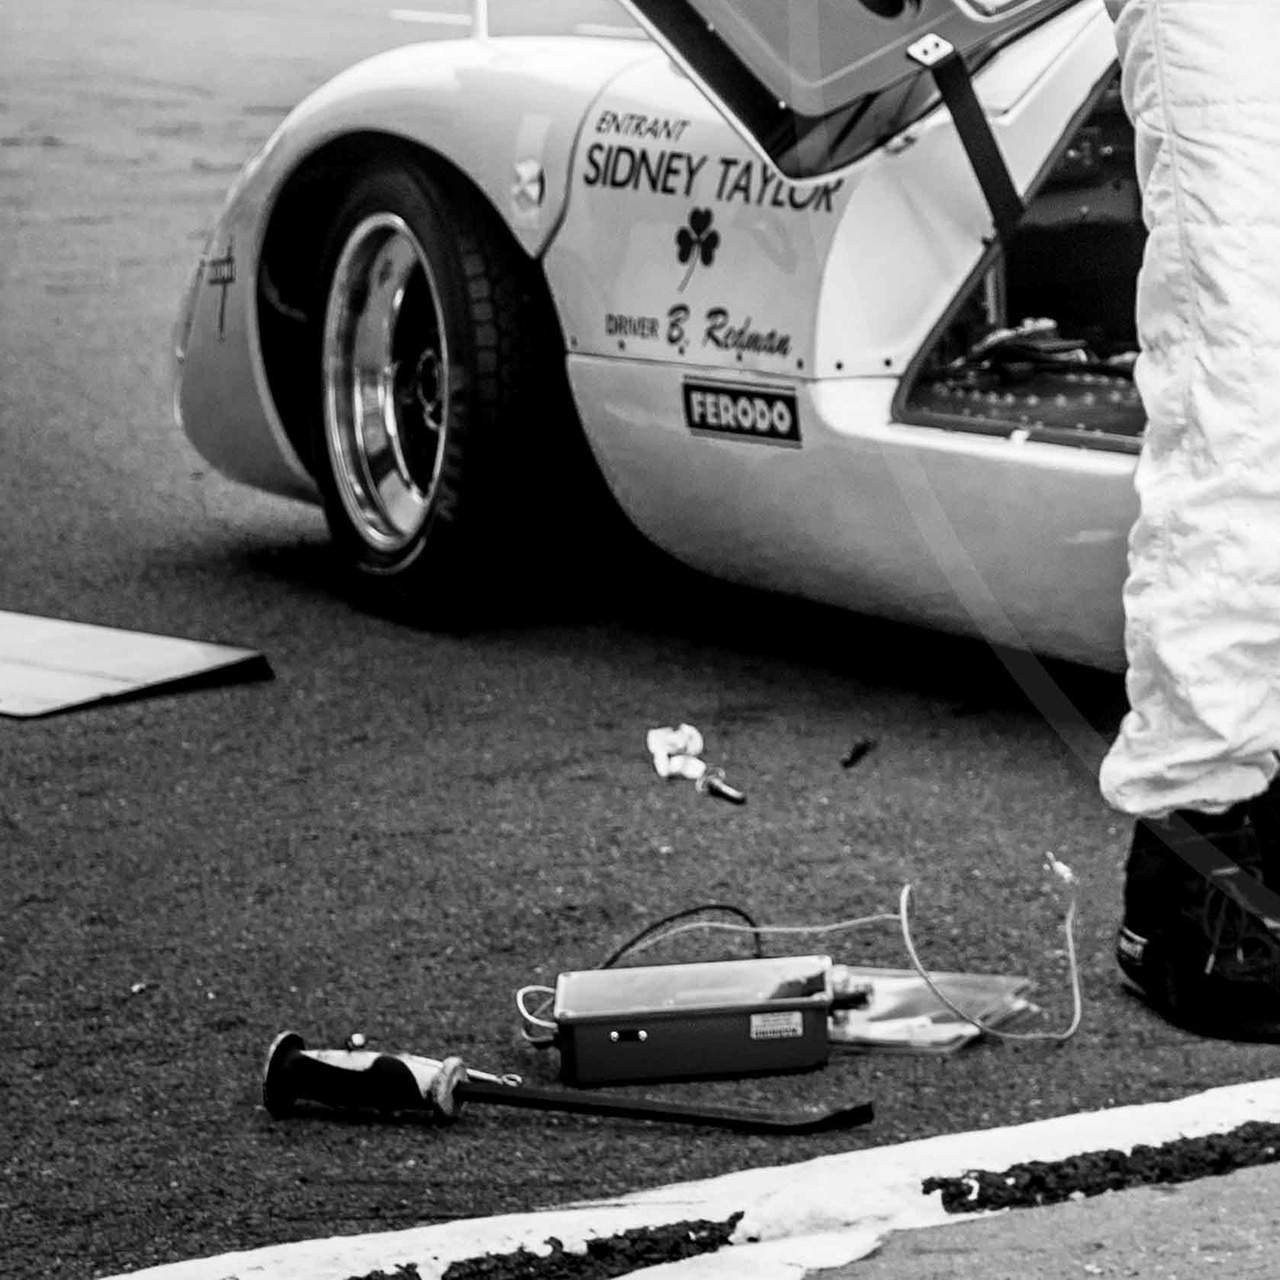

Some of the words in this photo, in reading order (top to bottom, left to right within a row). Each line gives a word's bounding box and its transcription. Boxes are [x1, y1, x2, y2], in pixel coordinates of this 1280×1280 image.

[596, 111, 690, 142] ENTRANT
[583, 143, 708, 197] SIDNEY
[605, 313, 660, 338] DRIVER
[703, 306, 793, 357] Redman
[689, 390, 792, 434] FERODO
